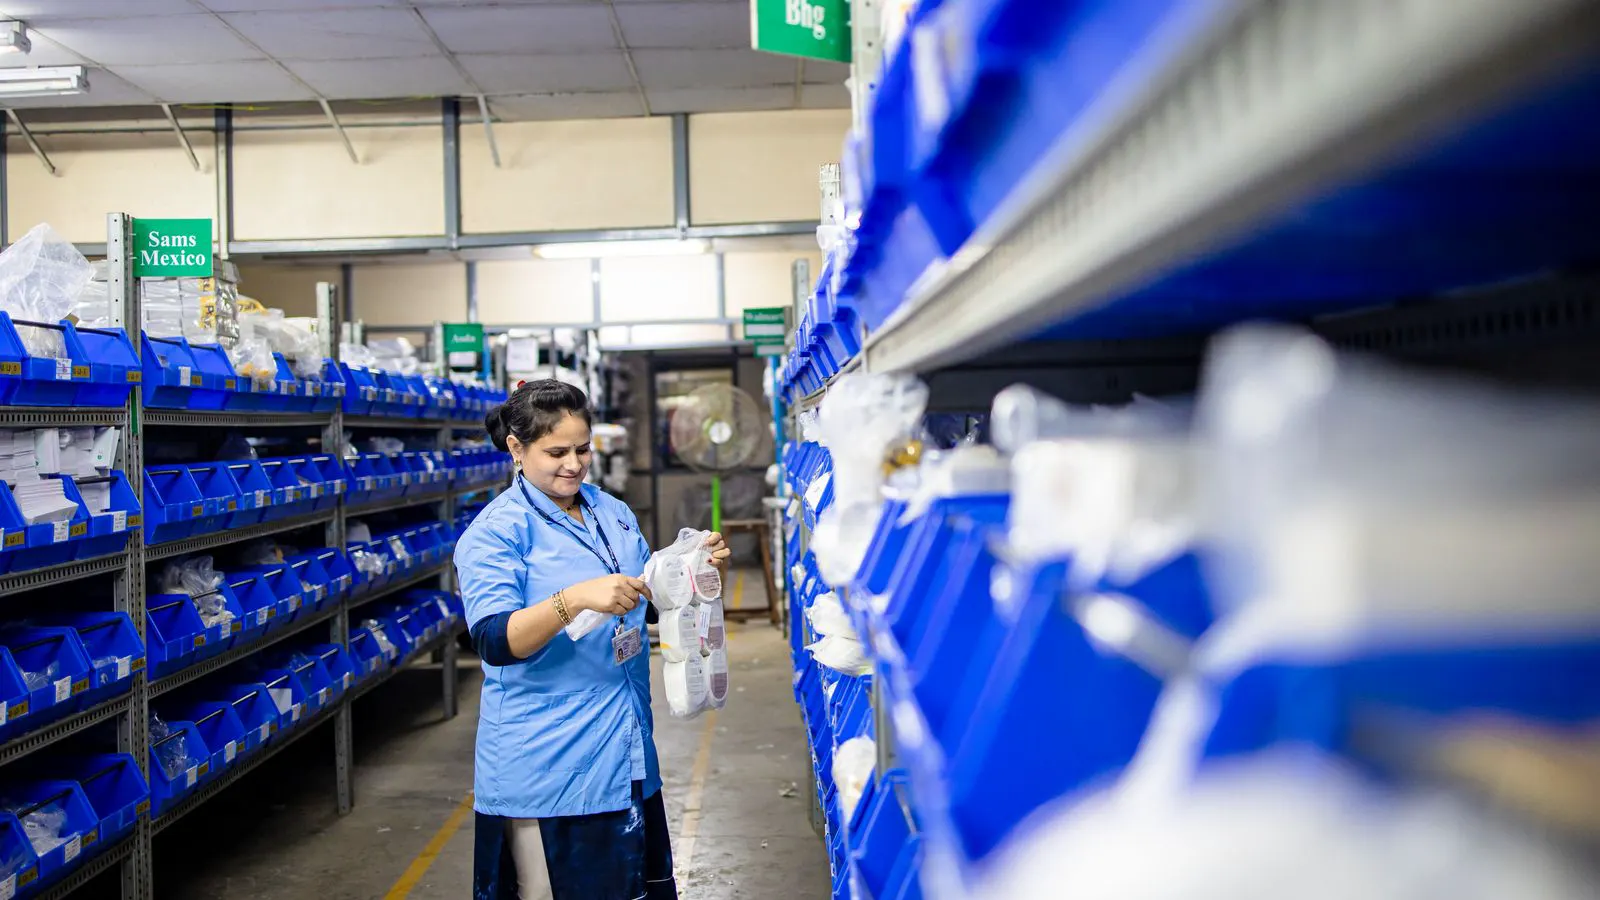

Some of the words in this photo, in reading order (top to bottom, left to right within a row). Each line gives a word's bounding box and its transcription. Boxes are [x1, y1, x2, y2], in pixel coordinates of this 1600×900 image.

[785, 0, 826, 40] Bhg
[148, 231, 197, 247] Sams
[141, 250, 206, 266] Mexico
